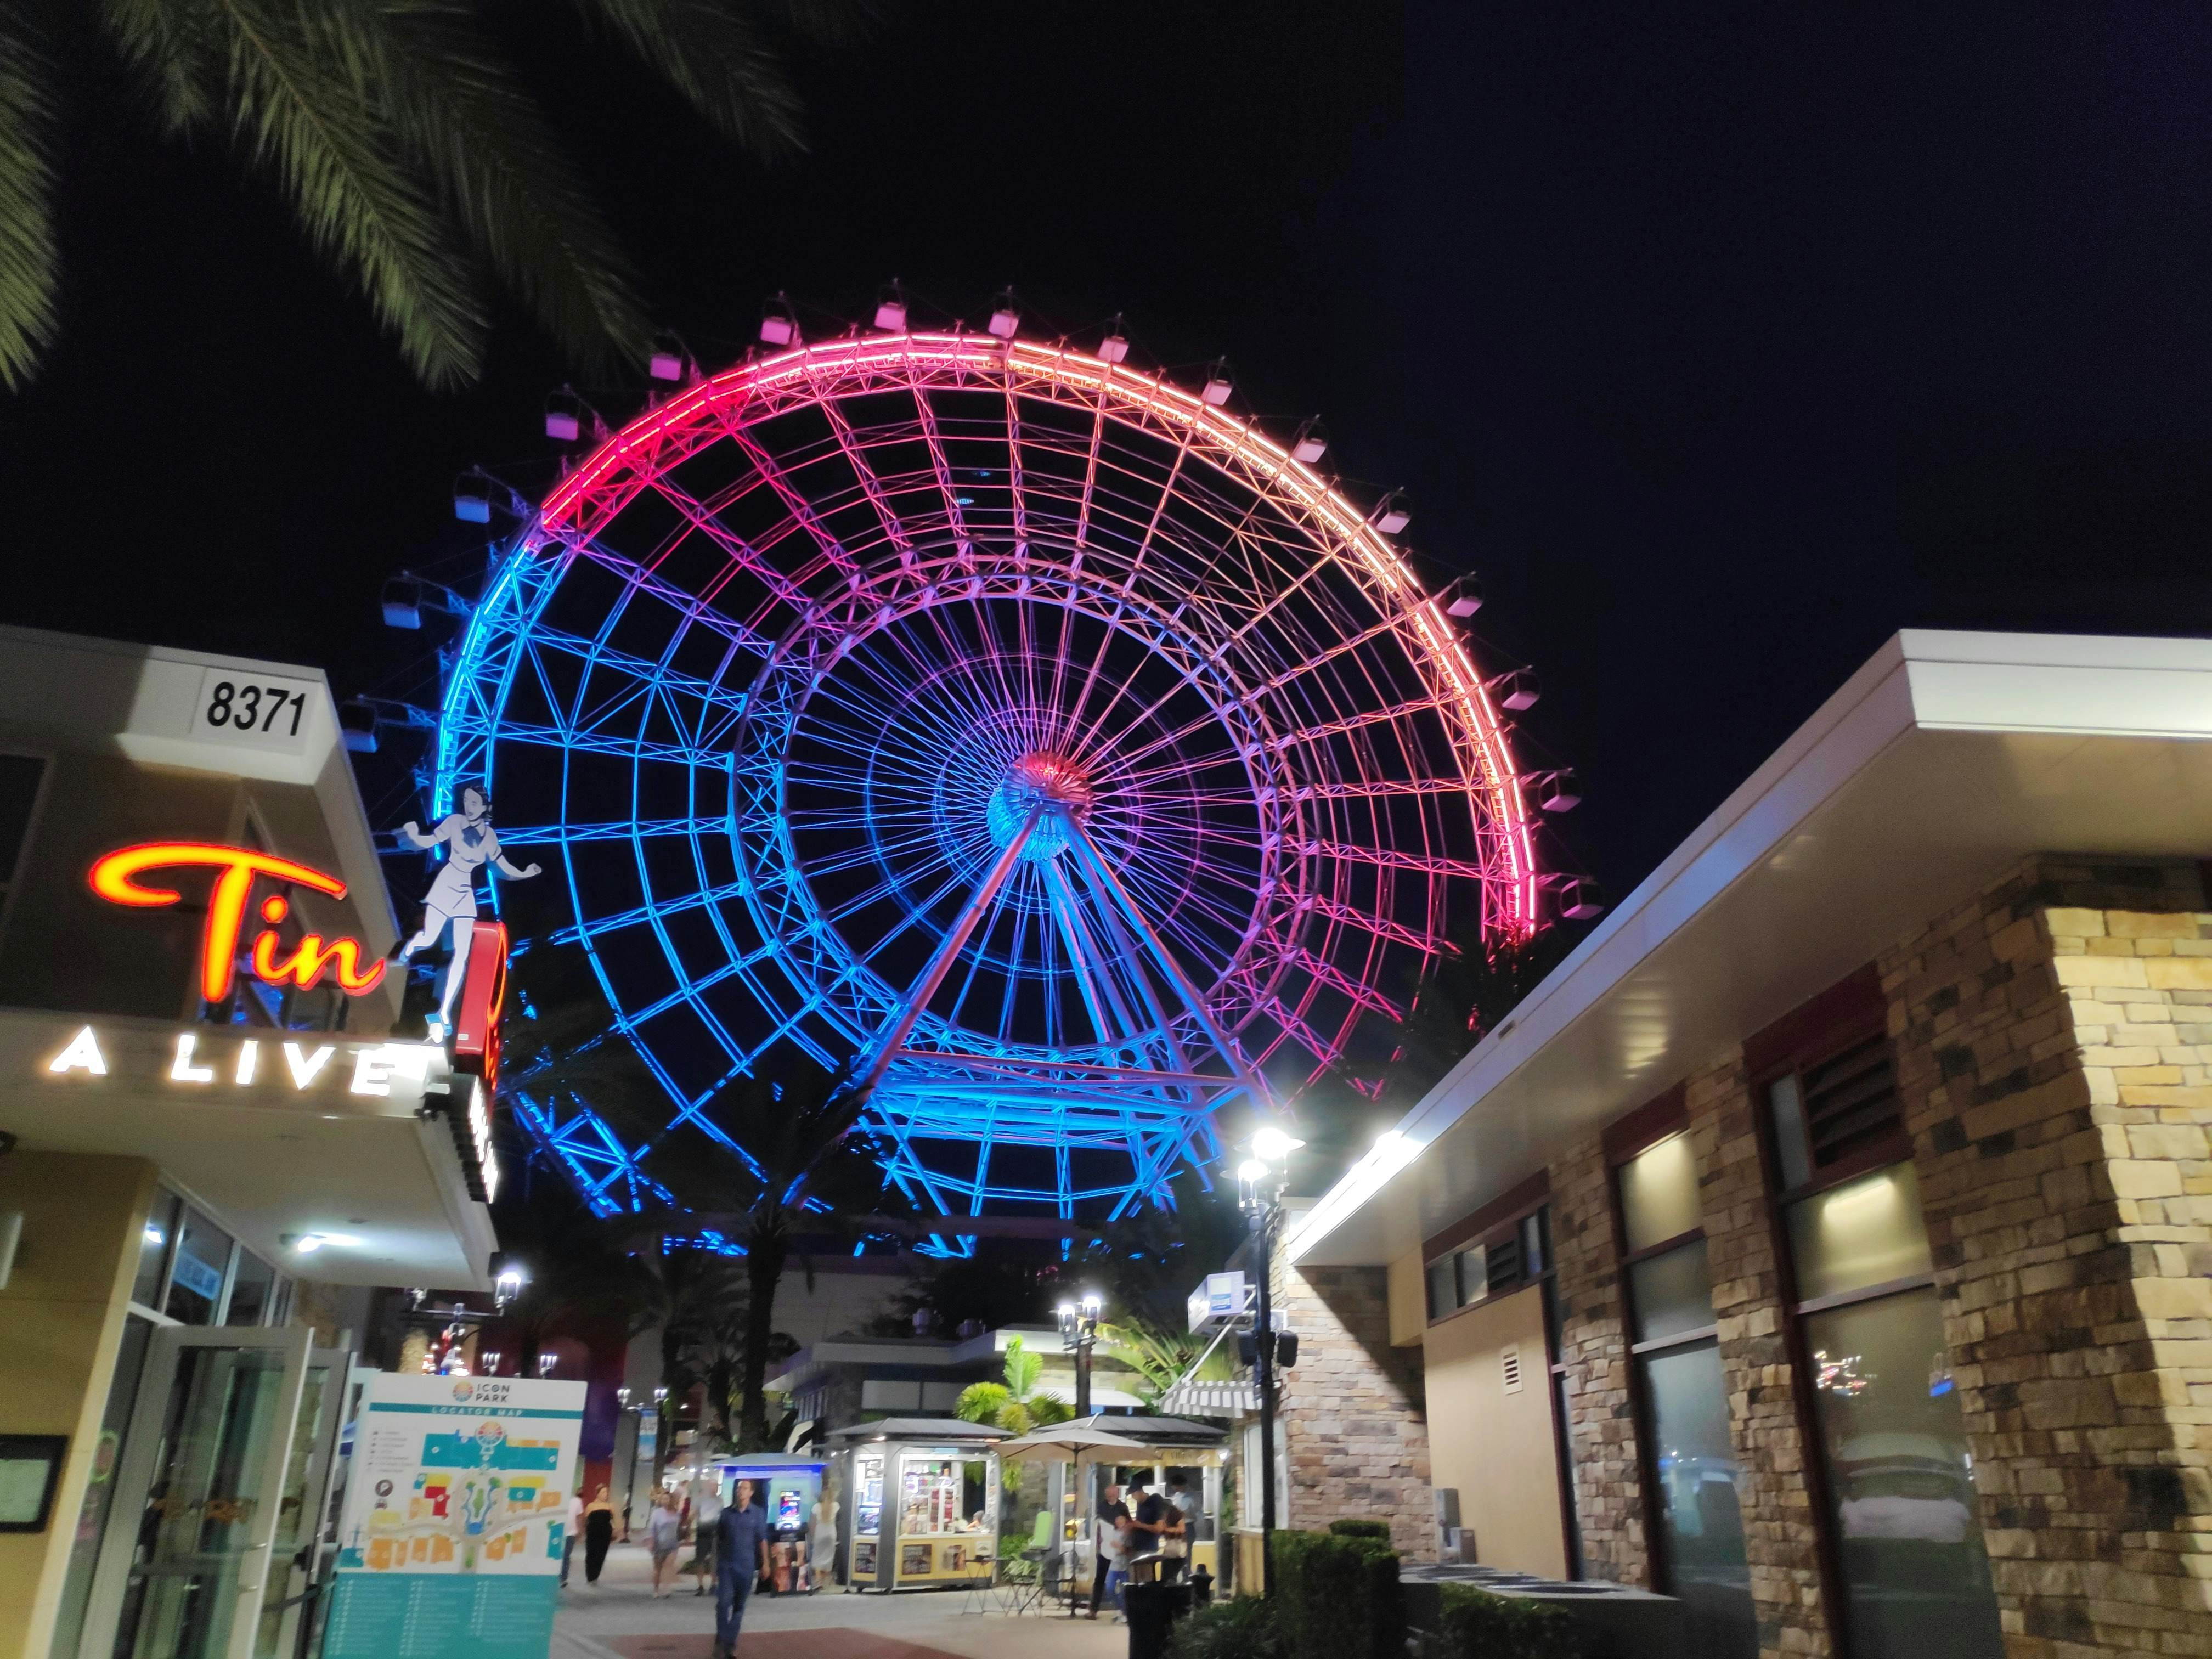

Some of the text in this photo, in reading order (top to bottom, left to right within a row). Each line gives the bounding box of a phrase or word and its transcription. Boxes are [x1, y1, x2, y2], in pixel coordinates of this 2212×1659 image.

[207, 681, 306, 736] 8371
[89, 841, 385, 1003] Tin
[49, 1025, 392, 1097] A LIVE
[475, 1393, 509, 1403] PARK
[477, 1384, 511, 1393] ICON
[432, 1406, 523, 1418] LOCATOR MAP
